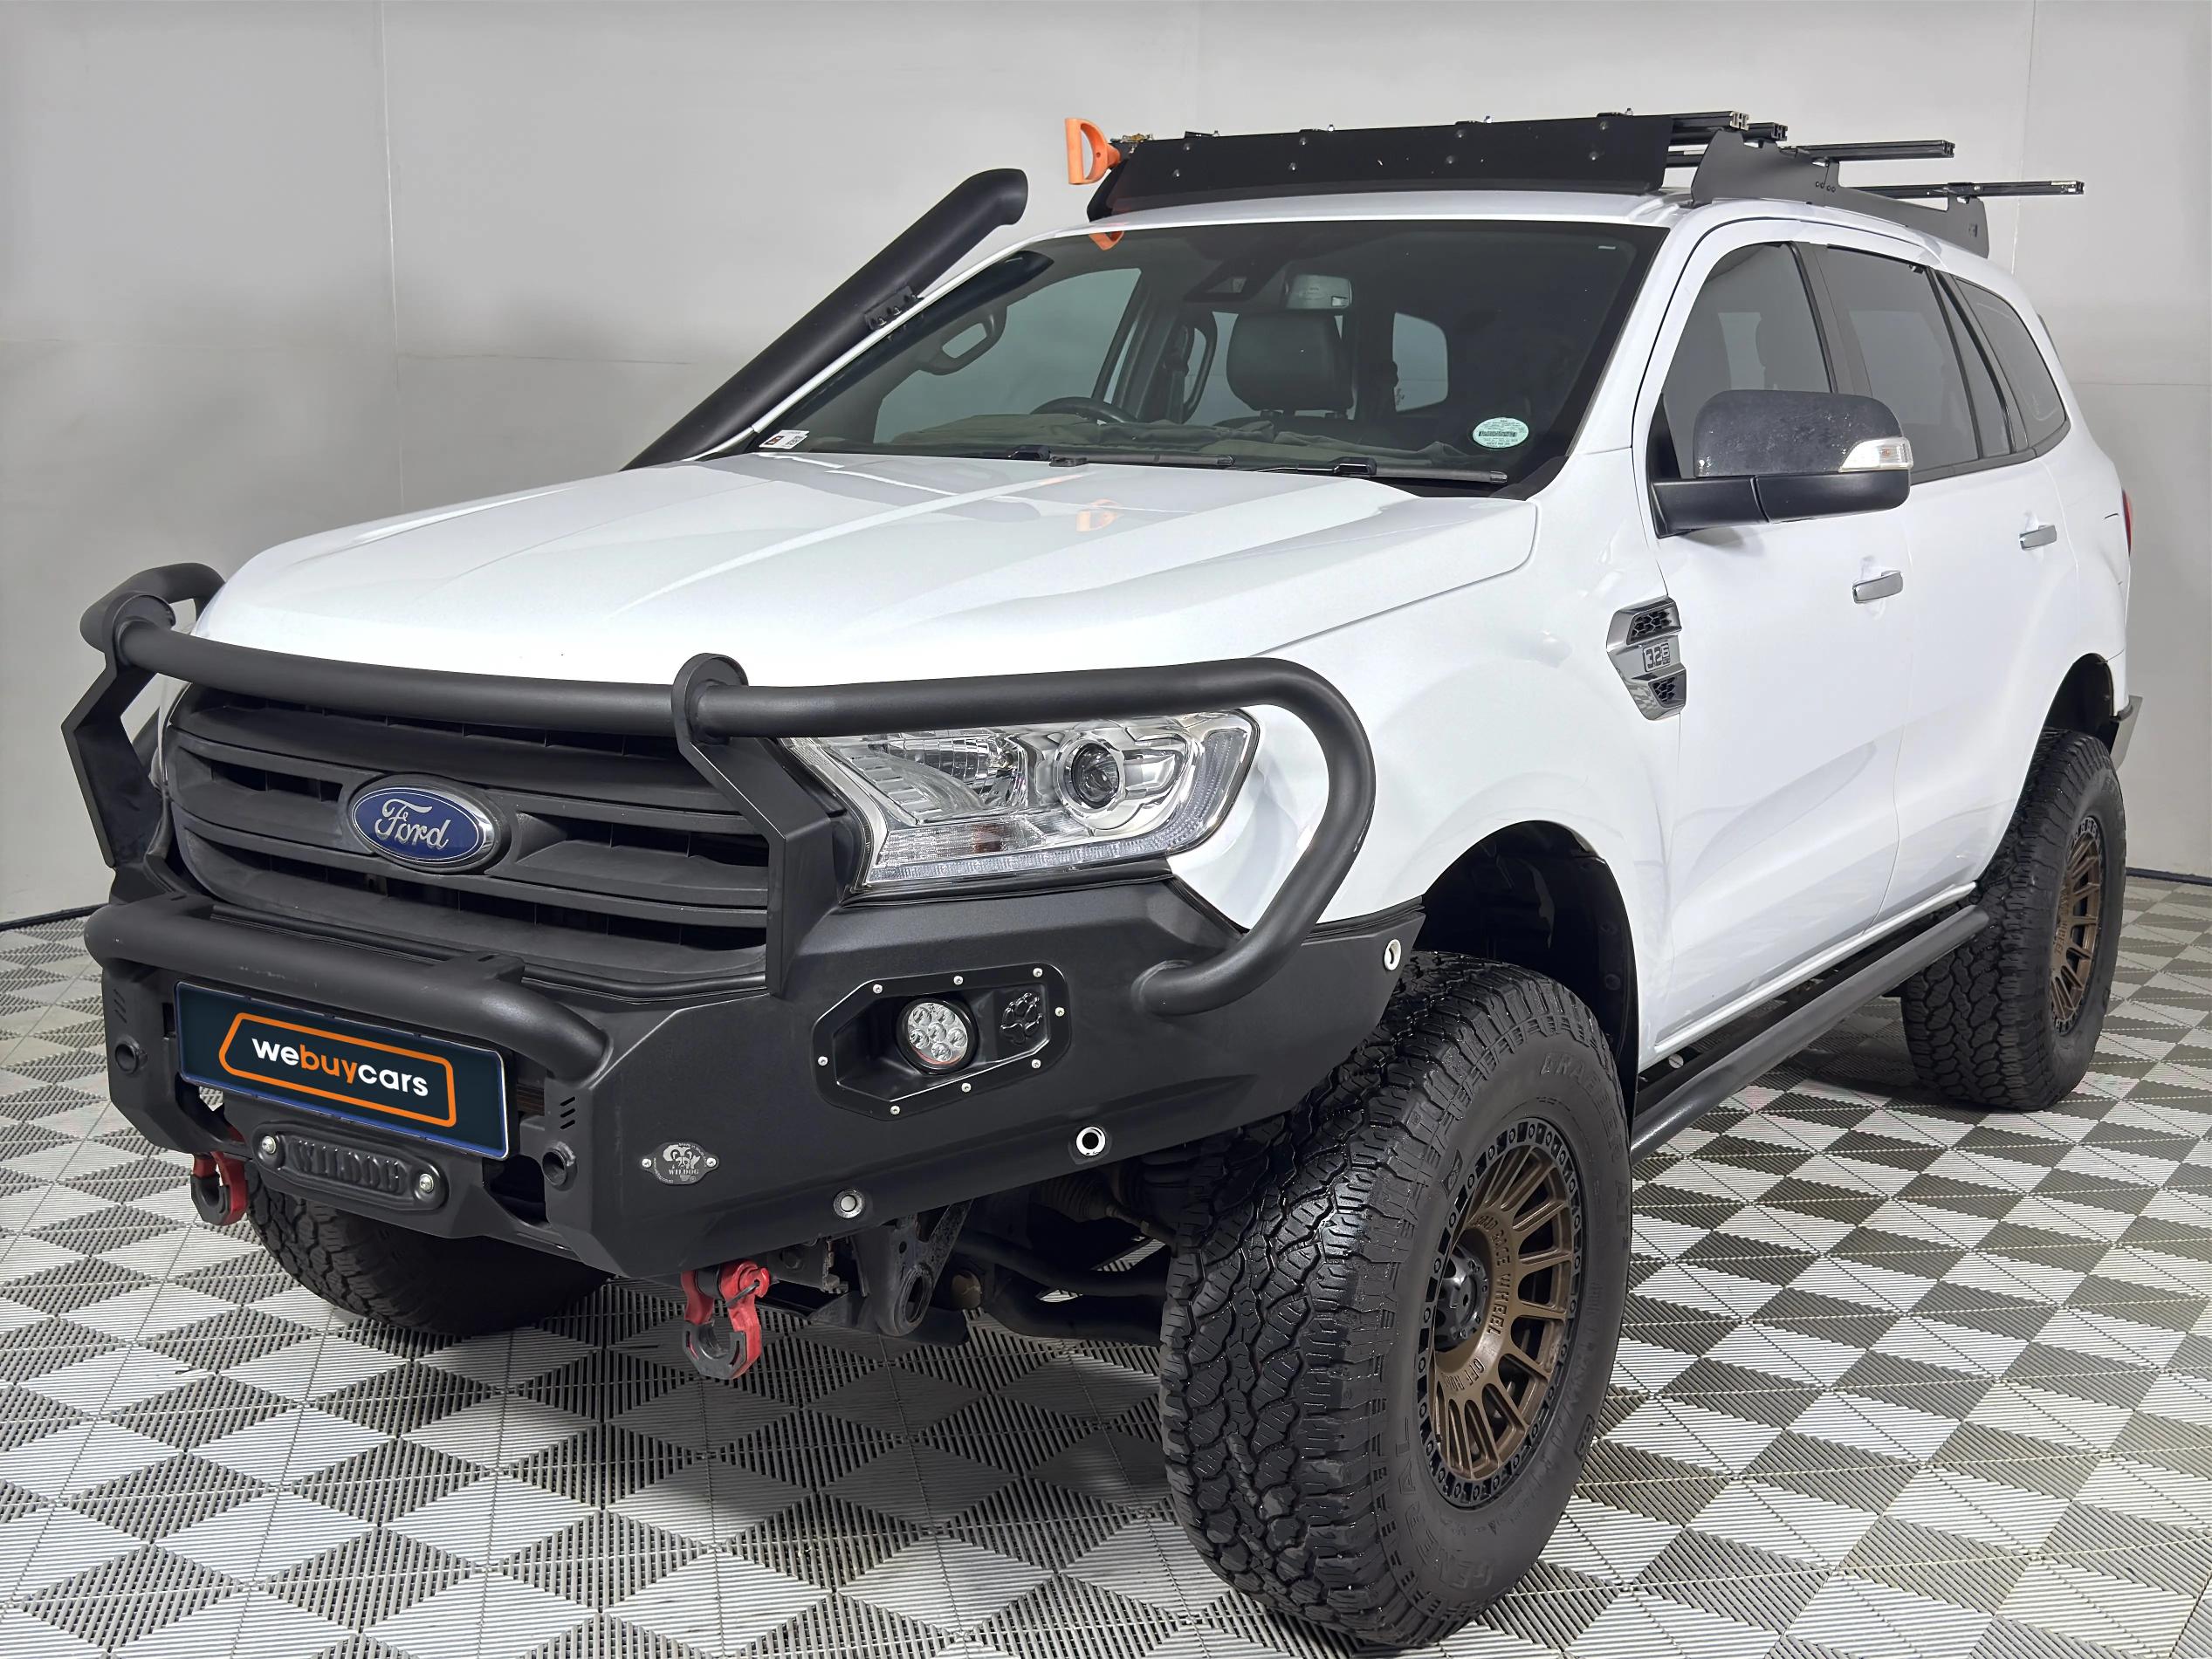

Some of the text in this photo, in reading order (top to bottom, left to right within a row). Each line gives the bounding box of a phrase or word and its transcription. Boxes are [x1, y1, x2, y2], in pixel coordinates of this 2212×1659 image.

[374, 799, 451, 851] Ford
[251, 1038, 429, 1097] webuycars
[1487, 1272, 1512, 1336] WHEEL
[1464, 1358, 1486, 1387] OFF
